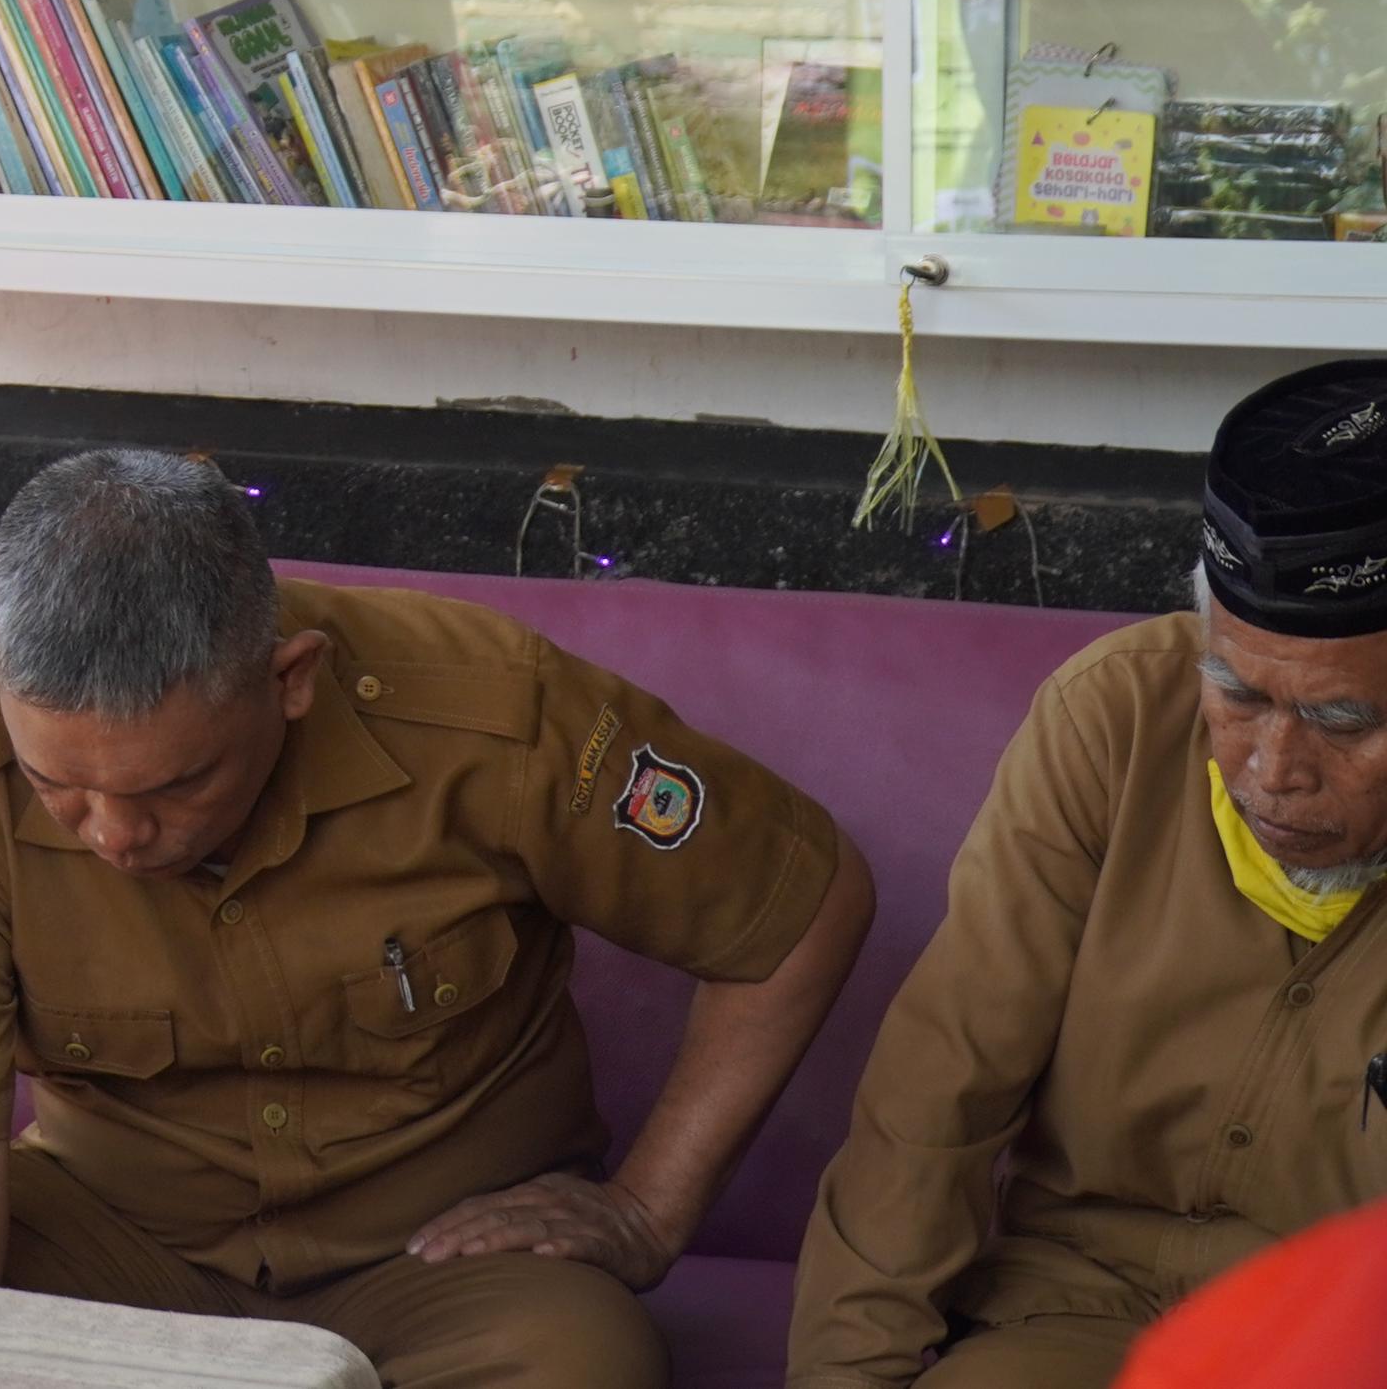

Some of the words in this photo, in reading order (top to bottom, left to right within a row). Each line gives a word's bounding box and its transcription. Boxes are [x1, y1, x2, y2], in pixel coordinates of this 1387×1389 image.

[551, 106, 570, 143] BOOK
[563, 104, 584, 152] POCKET
[1052, 151, 1117, 169] Belajar
[1044, 168, 1125, 186] kosakata
[1033, 182, 1133, 202] sehari-hari
